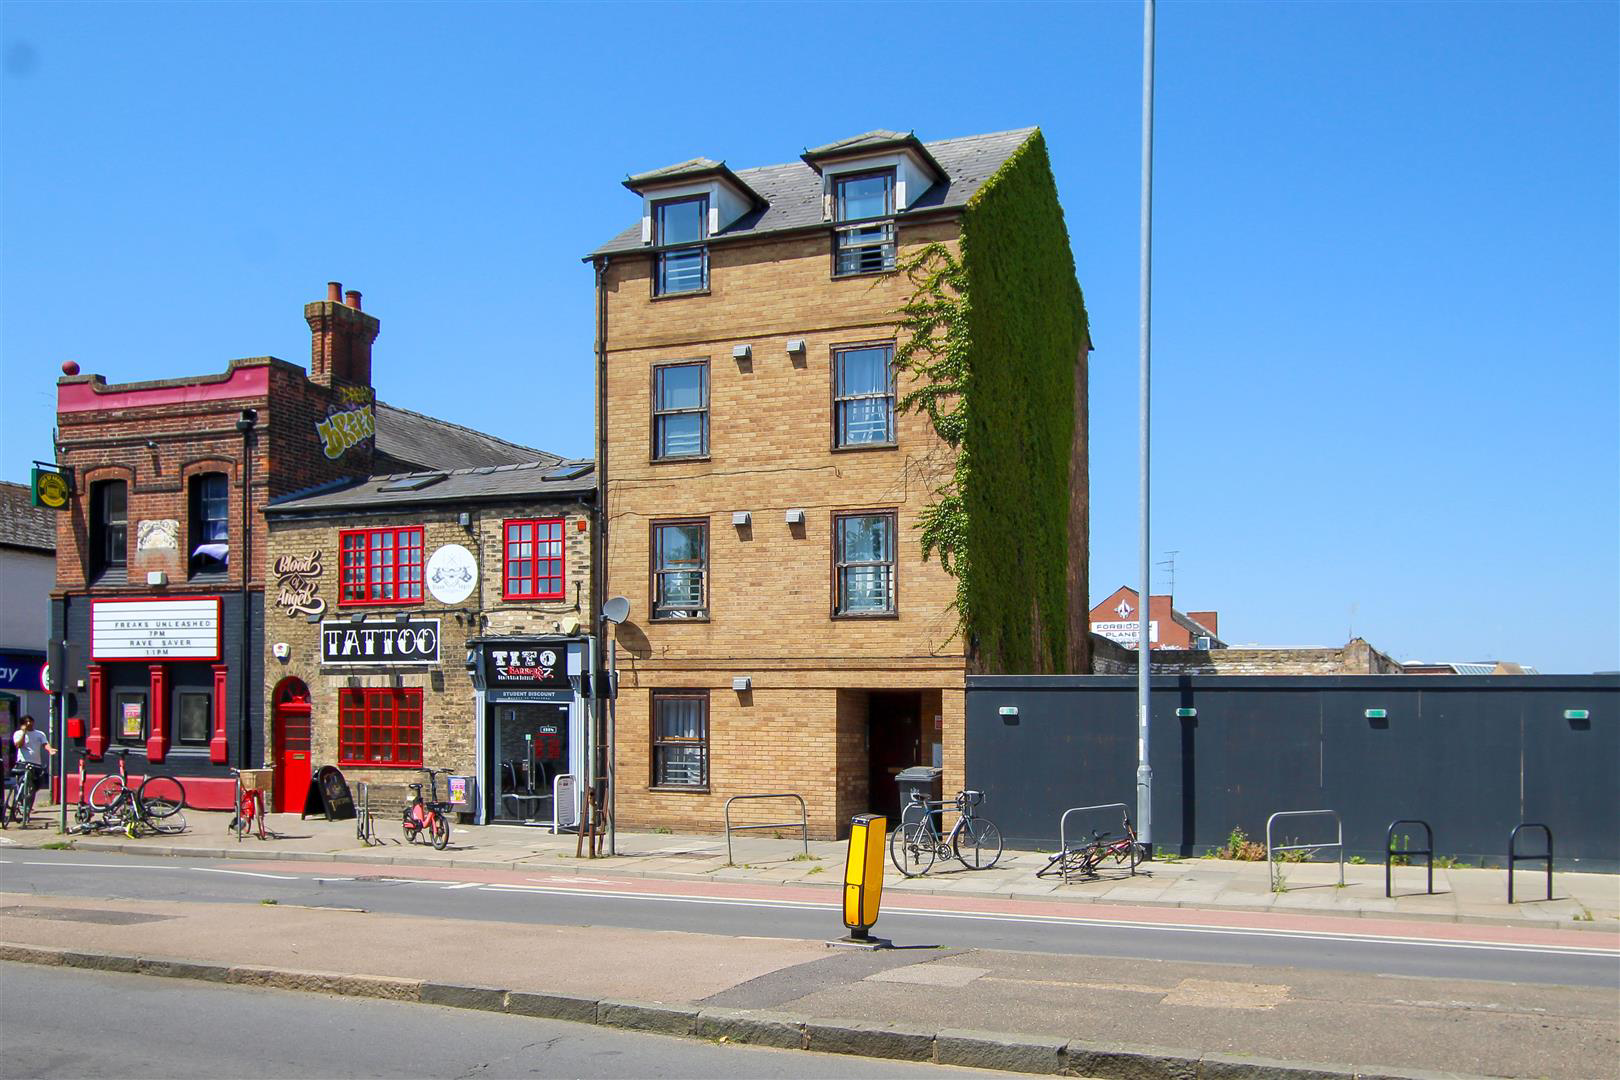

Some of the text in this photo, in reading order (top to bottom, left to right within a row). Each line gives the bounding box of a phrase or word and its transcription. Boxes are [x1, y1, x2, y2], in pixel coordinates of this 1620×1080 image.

[272, 549, 321, 578] Blood
[275, 582, 326, 616] Angels
[156, 620, 211, 628] UNLEASHED
[324, 628, 437, 656] TATTOO
[492, 650, 557, 667] TITO
